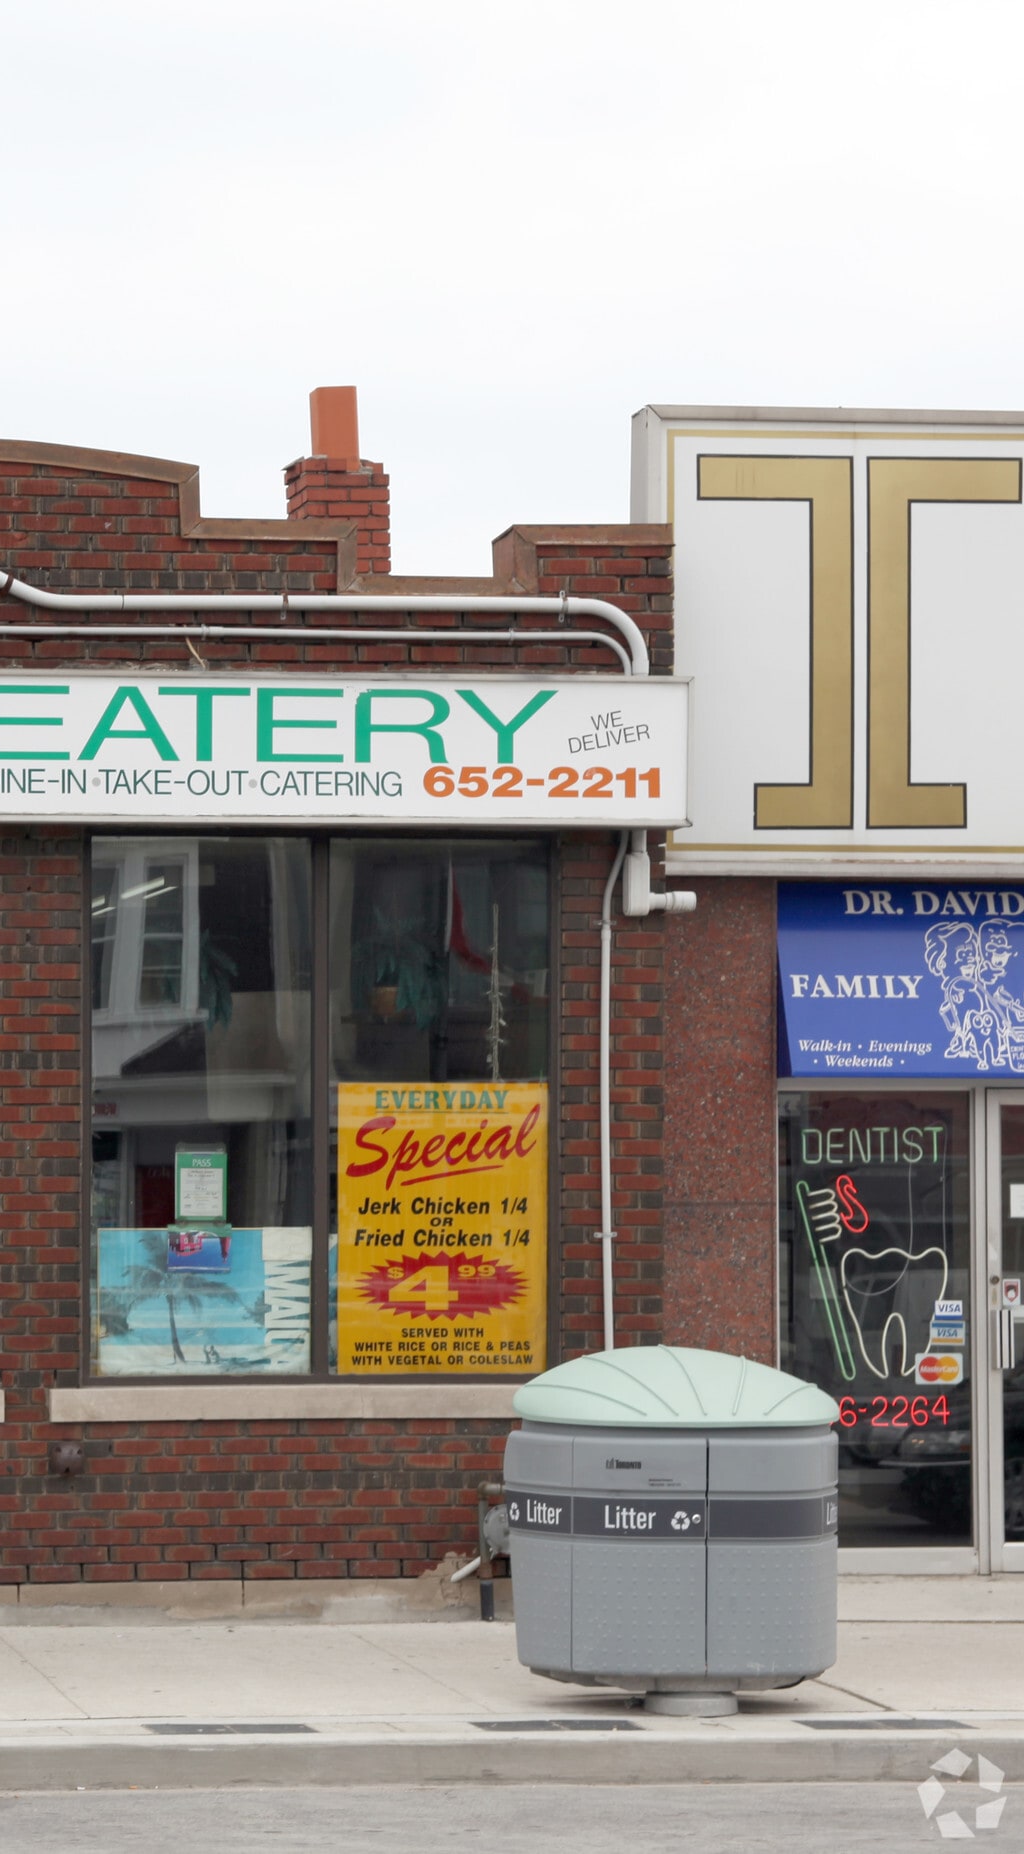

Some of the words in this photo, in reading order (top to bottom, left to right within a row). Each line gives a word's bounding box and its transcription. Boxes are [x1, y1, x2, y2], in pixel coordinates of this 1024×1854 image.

[590, 710, 624, 731] WE
[567, 724, 651, 755] DELIVER
[100, 769, 249, 797] TAKE-OUT
[259, 771, 403, 798] CATERING
[423, 765, 662, 798] 652-2211
[842, 889, 905, 915] DR.
[912, 890, 1024, 916] DAVID
[789, 973, 924, 999] FAMILY
[798, 1039, 852, 1053] Walk-in
[868, 1040, 932, 1054] Evenings
[825, 1055, 893, 1068] Weekends
[375, 1089, 510, 1110] EVERYDAY
[345, 1103, 541, 1190] Special
[801, 1126, 944, 1164] DENTIST
[192, 1158, 212, 1168] PASS
[358, 1197, 402, 1216] Jerk
[411, 1197, 490, 1215] Chicken
[500, 1197, 528, 1215] 1/4
[430, 1217, 454, 1227] OR
[354, 1229, 404, 1248] Fried
[412, 1228, 493, 1247] Chicken
[502, 1228, 531, 1247] 1/4
[938, 1303, 961, 1313] VISA
[401, 1327, 450, 1339] SERVED
[454, 1326, 484, 1338] WITH
[937, 1328, 958, 1337] VISA
[354, 1341, 394, 1352] WHITE
[397, 1341, 428, 1352] RICE
[431, 1341, 448, 1352] OR
[451, 1340, 482, 1352] RICE
[486, 1341, 495, 1351] &
[498, 1340, 531, 1352] PEAS
[352, 1355, 383, 1366] WITH
[387, 1354, 444, 1366] VEGETAL
[447, 1354, 465, 1366] OR
[469, 1354, 534, 1366] COLESLAW
[829, 1394, 951, 1428] 6-2264
[526, 1499, 562, 1525] Litter
[604, 1505, 656, 1529] Litter
